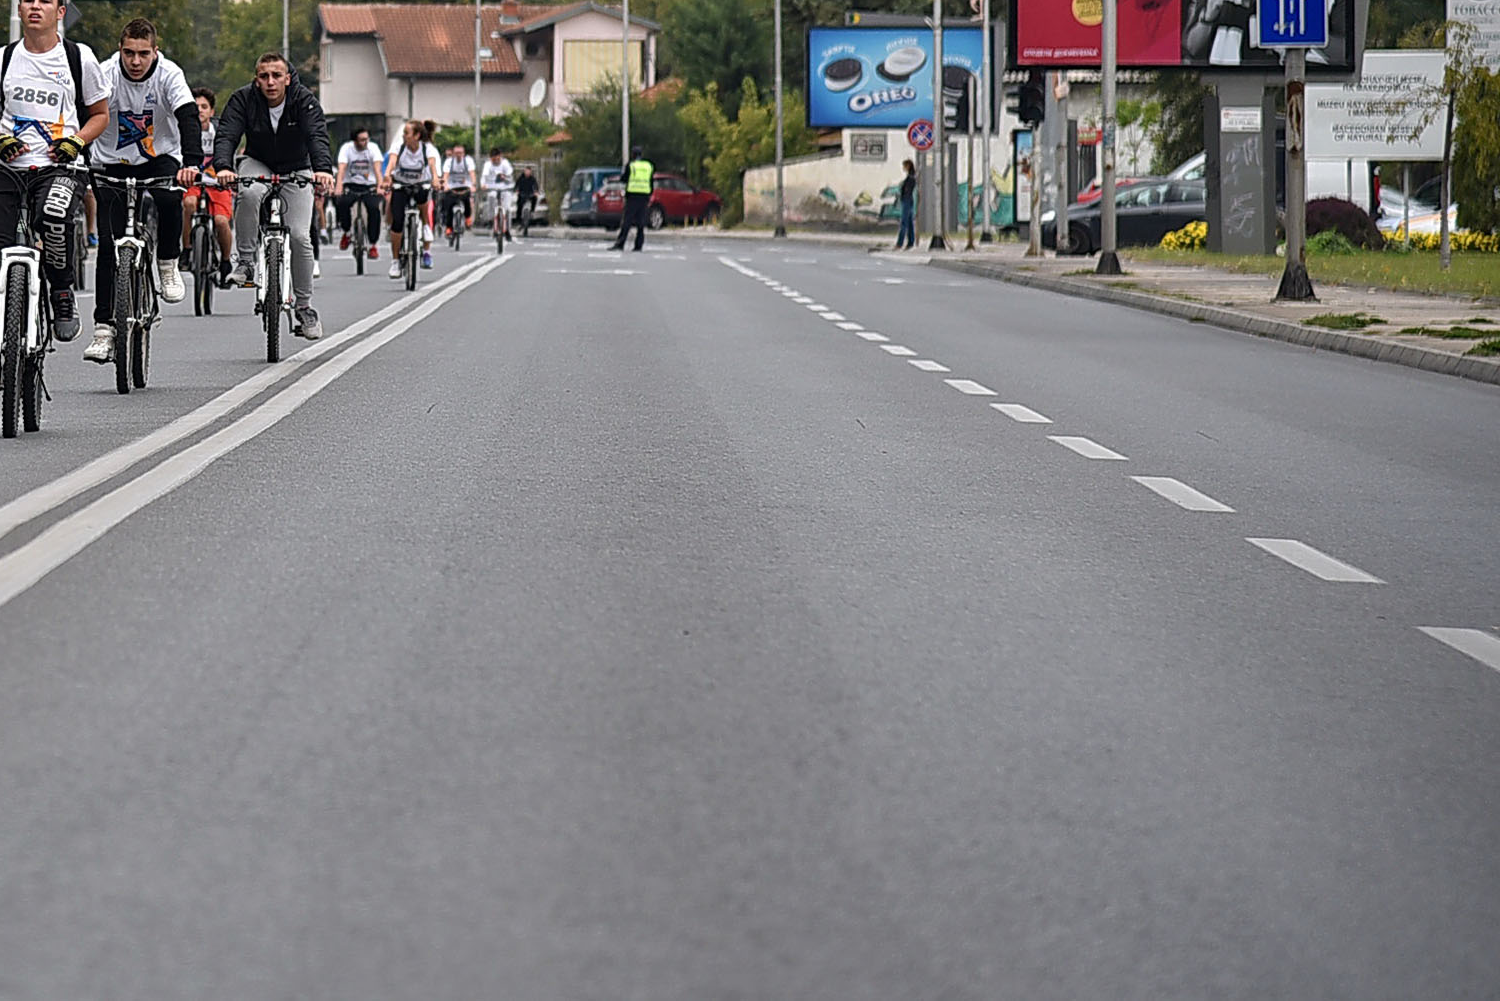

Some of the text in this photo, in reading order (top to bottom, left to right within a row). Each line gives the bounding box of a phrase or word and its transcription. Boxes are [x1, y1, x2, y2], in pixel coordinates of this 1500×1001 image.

[13, 86, 59, 107] 2856
[849, 86, 917, 112] OREO
[43, 183, 74, 218] HERO
[42, 220, 67, 270] POWER
